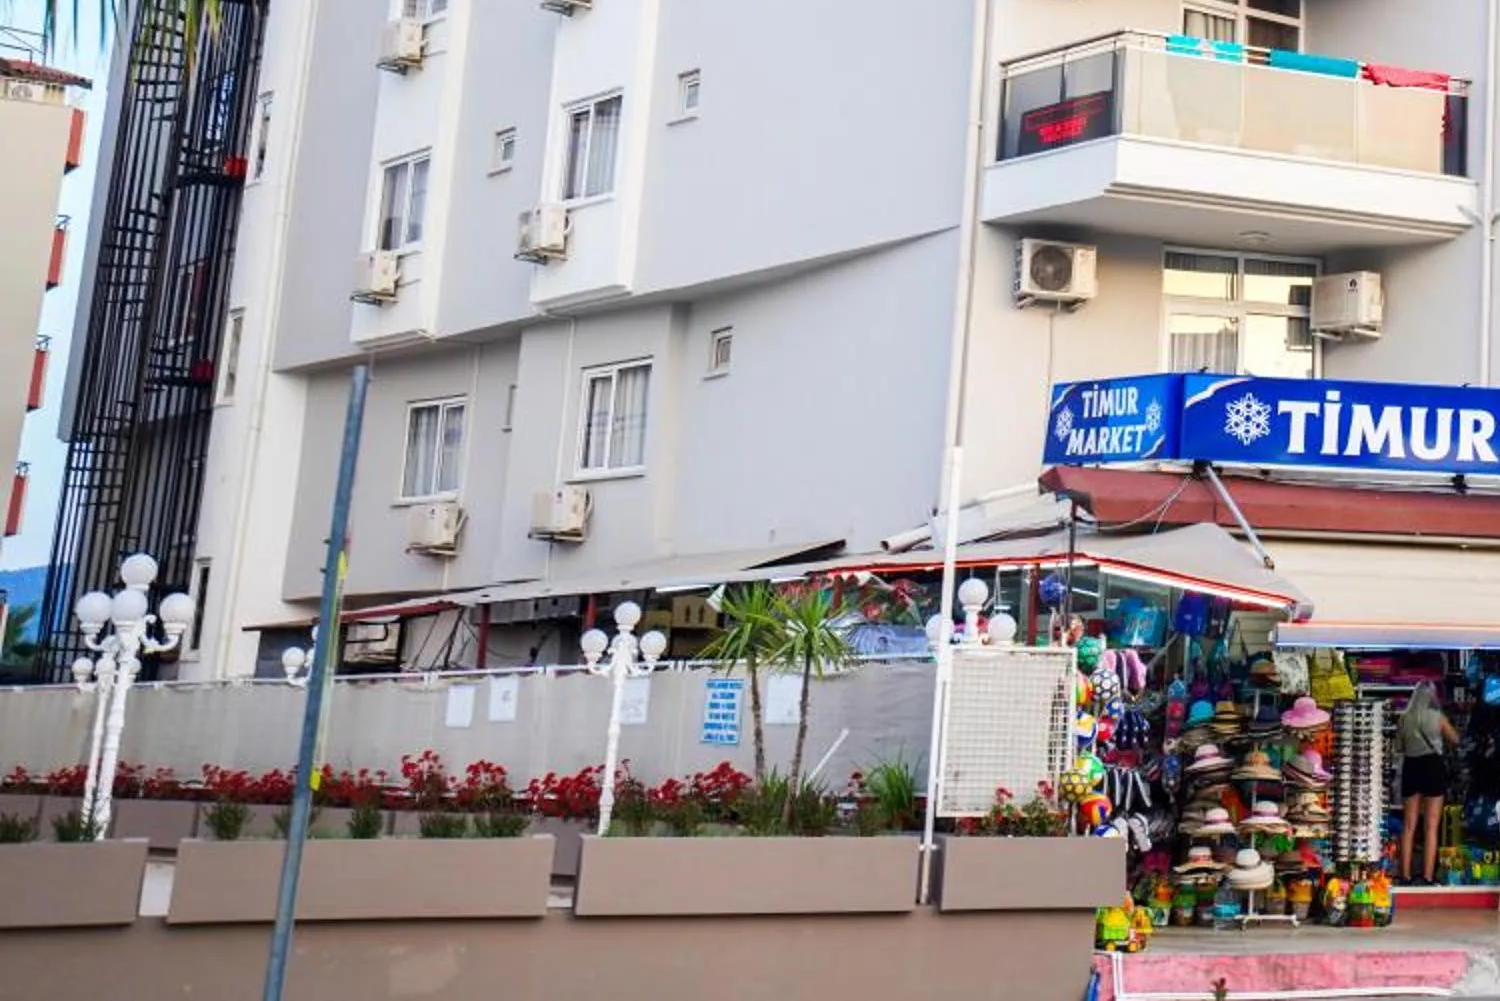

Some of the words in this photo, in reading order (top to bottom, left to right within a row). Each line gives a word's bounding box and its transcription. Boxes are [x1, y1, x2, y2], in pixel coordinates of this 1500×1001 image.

[1081, 384, 1139, 419] TİMUR
[1065, 424, 1147, 456] MARKET
[1277, 390, 1499, 463] TİMUR
